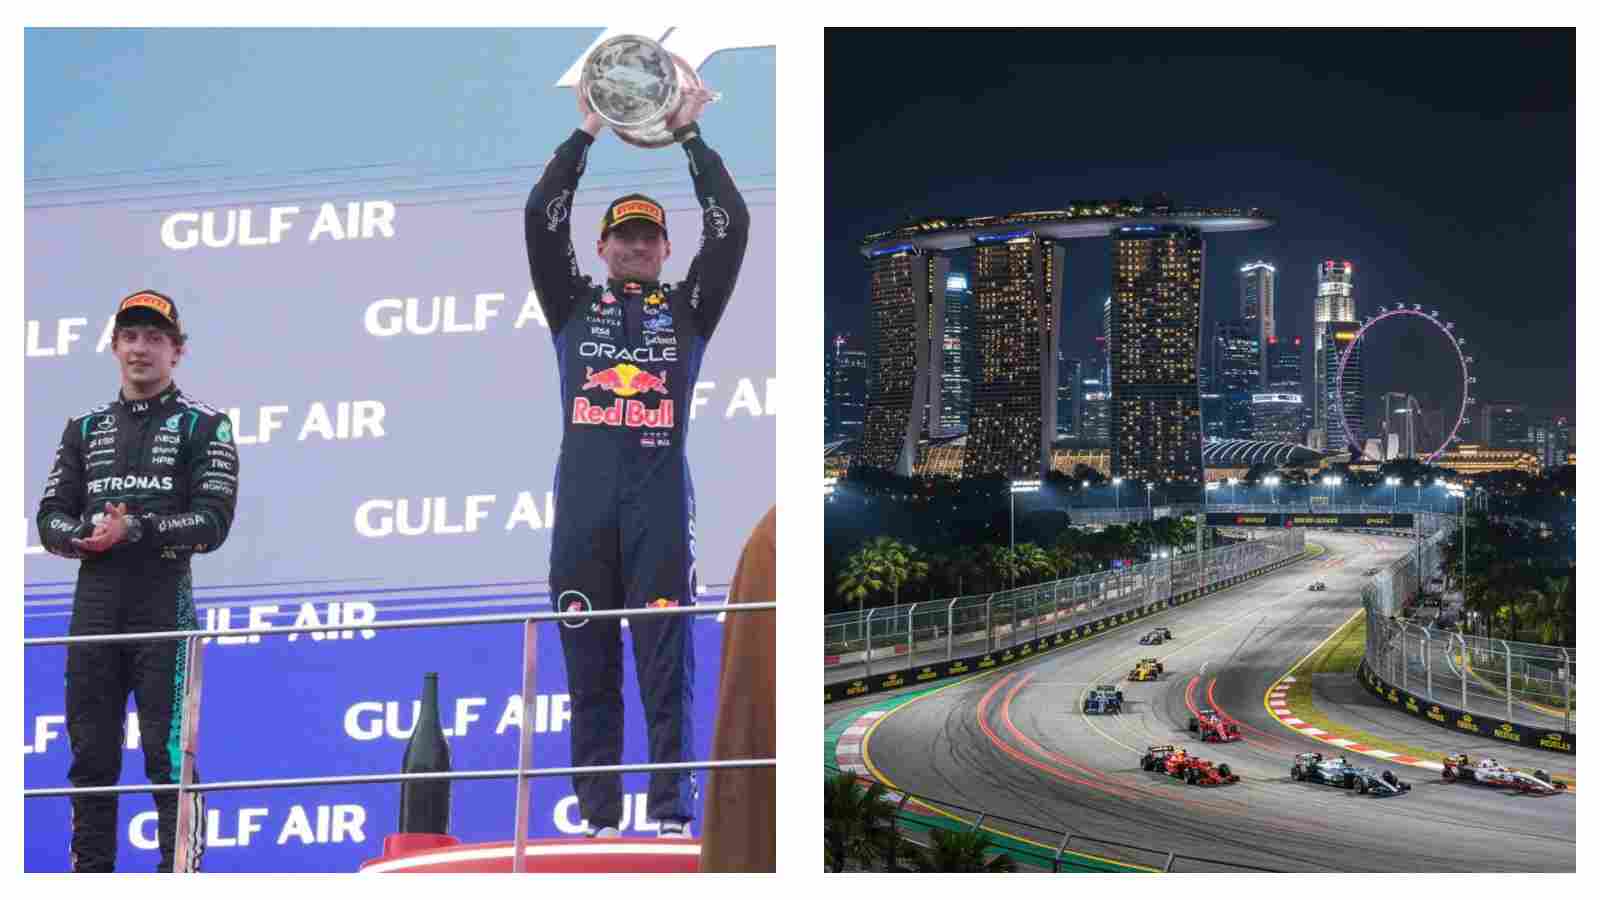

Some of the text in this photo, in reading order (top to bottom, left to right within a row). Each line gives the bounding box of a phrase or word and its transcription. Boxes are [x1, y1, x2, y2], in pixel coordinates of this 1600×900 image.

[160, 199, 397, 251] GULF AIR
[364, 292, 505, 338] GULF
[26, 317, 88, 358] LF
[579, 342, 678, 362] ORACLE
[572, 397, 623, 425] Red
[625, 399, 674, 428] Bull
[724, 377, 776, 419] AI
[228, 399, 387, 447] LF AIR
[87, 475, 174, 495] PETRONAS
[353, 491, 553, 538] GULF AI
[288, 601, 377, 642] AIR
[129, 805, 366, 849] GLF AIR
